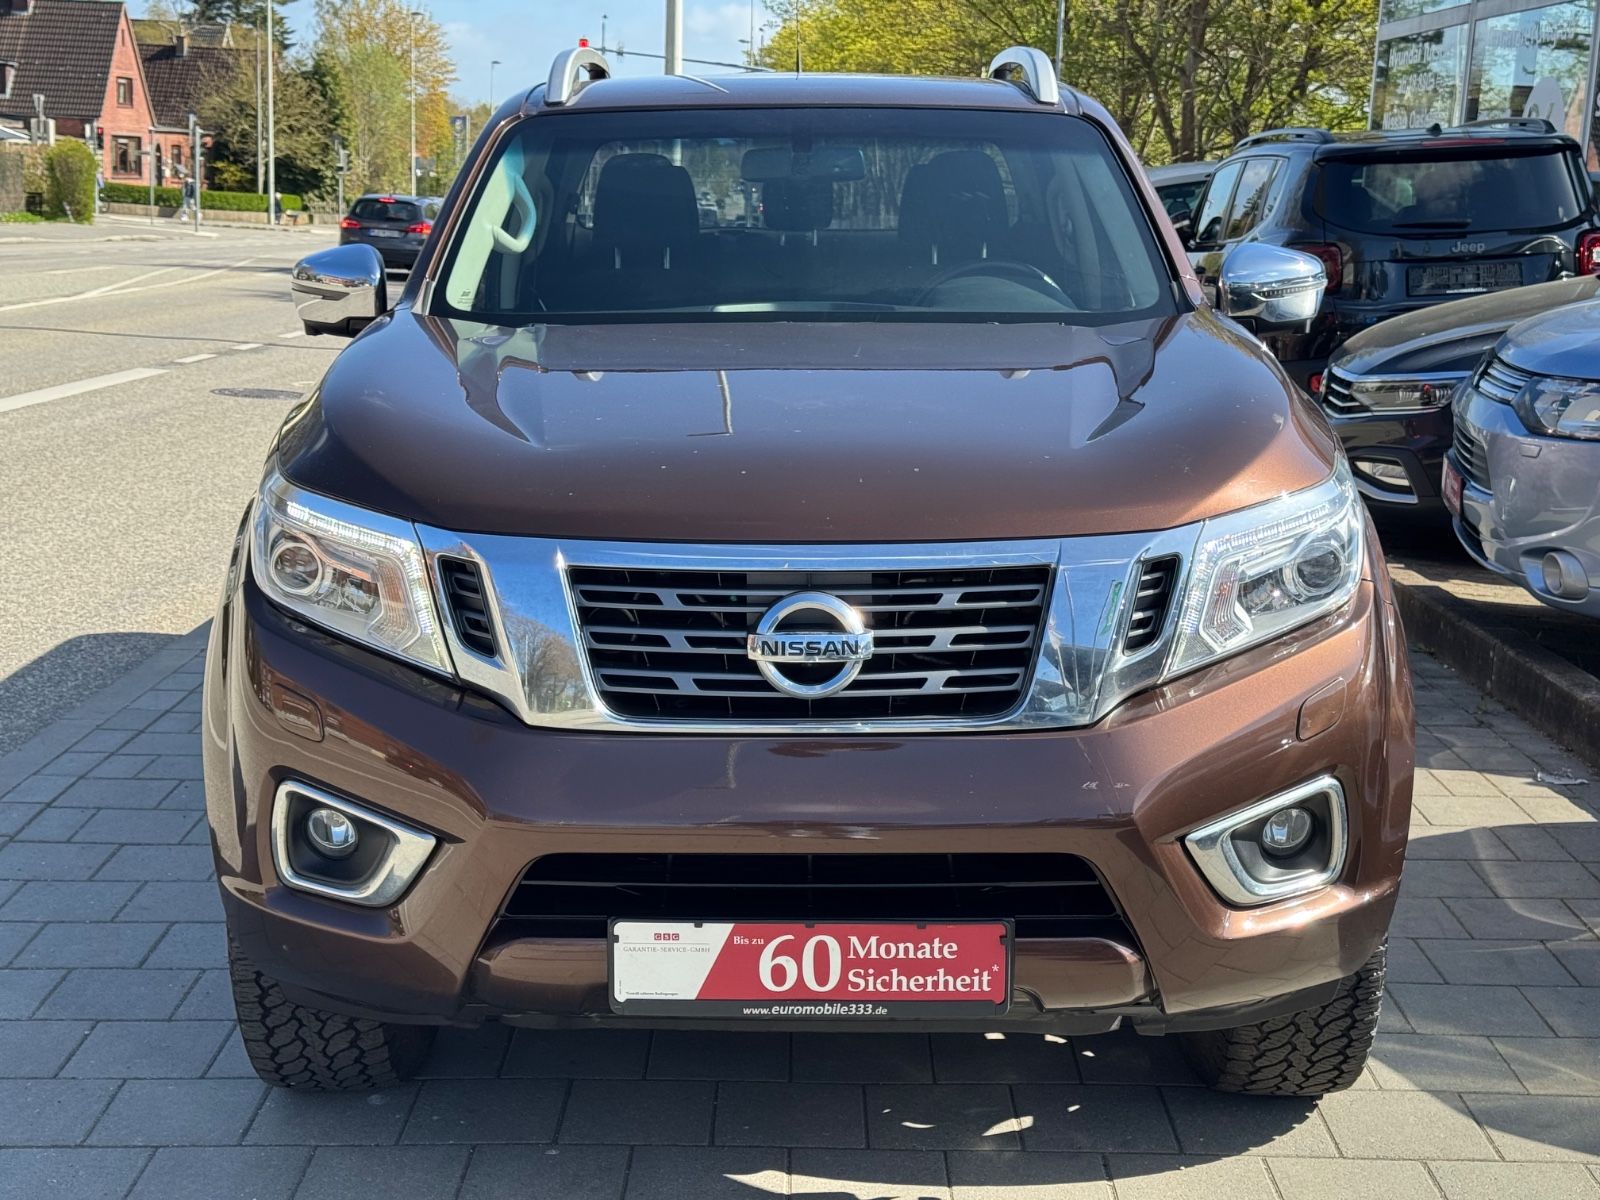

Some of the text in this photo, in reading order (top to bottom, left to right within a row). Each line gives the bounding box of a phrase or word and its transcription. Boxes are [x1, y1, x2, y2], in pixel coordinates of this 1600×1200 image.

[1452, 241, 1486, 254] Jeep
[761, 640, 859, 656] NISSAN
[654, 933, 680, 941] GSG
[733, 935, 765, 945] Bis zu
[847, 936, 959, 960] Monate
[758, 934, 842, 993] 60
[742, 1003, 888, 1016] www.euromobile333.de
